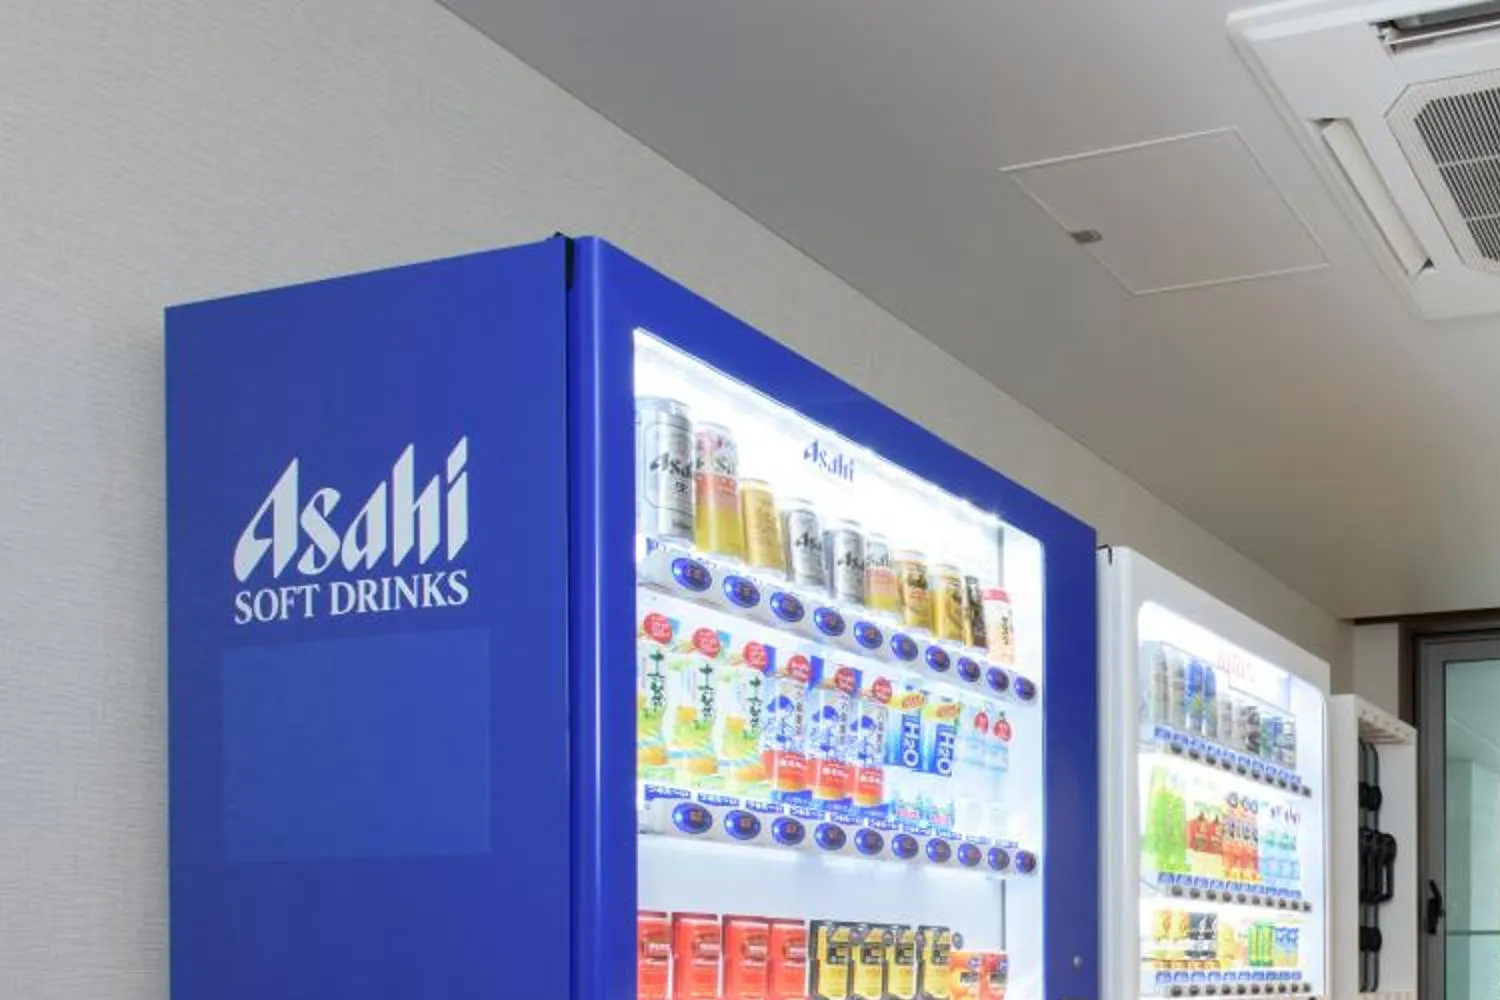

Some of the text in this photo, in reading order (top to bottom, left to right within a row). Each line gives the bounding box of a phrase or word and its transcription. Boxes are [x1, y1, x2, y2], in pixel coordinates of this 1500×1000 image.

[803, 438, 855, 483] Asahi
[233, 434, 469, 583] Asahi
[234, 569, 469, 625] SOFT DRINKS
